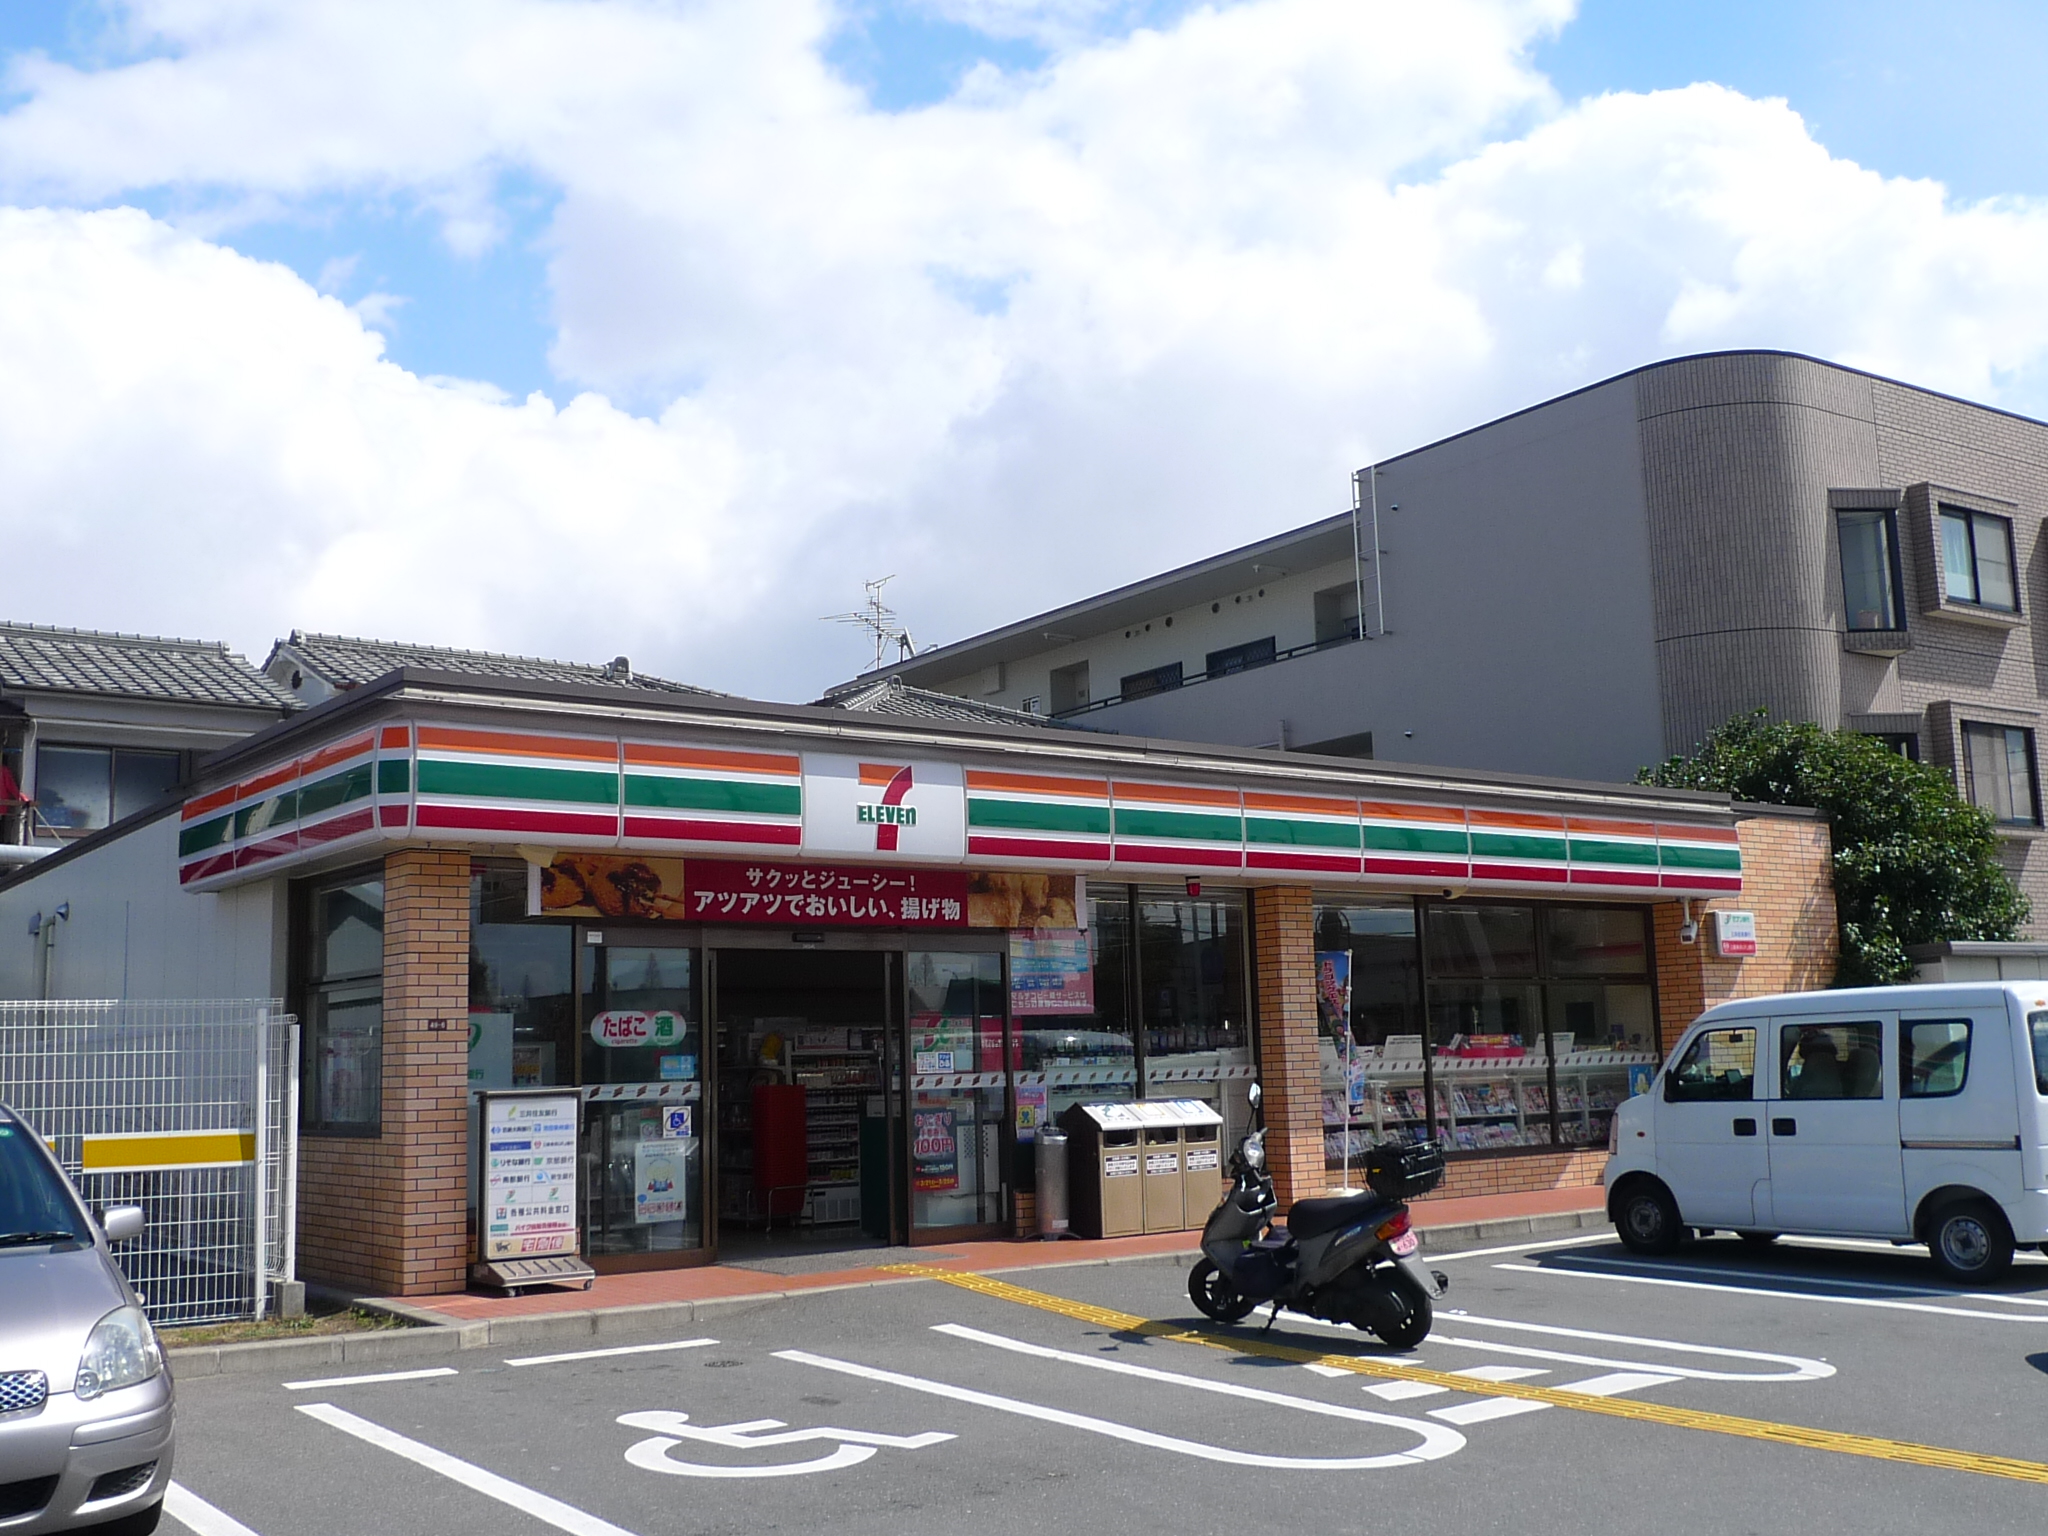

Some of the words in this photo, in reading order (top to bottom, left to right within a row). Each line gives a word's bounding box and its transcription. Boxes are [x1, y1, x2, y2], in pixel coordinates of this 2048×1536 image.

[746, 868, 916, 892] サクッとジューシー！
[693, 890, 962, 921] アツアツでおいしい、揚げ物
[602, 1015, 647, 1037] たばこ
[655, 1016, 674, 1036] 酒
[520, 1108, 558, 1118] 三井住友銀行
[914, 1136, 955, 1154] 100円
[500, 1158, 531, 1166] りそな銀行
[510, 1204, 570, 1218] 各種公共料金窓口
[521, 1236, 564, 1252] 宅急便
